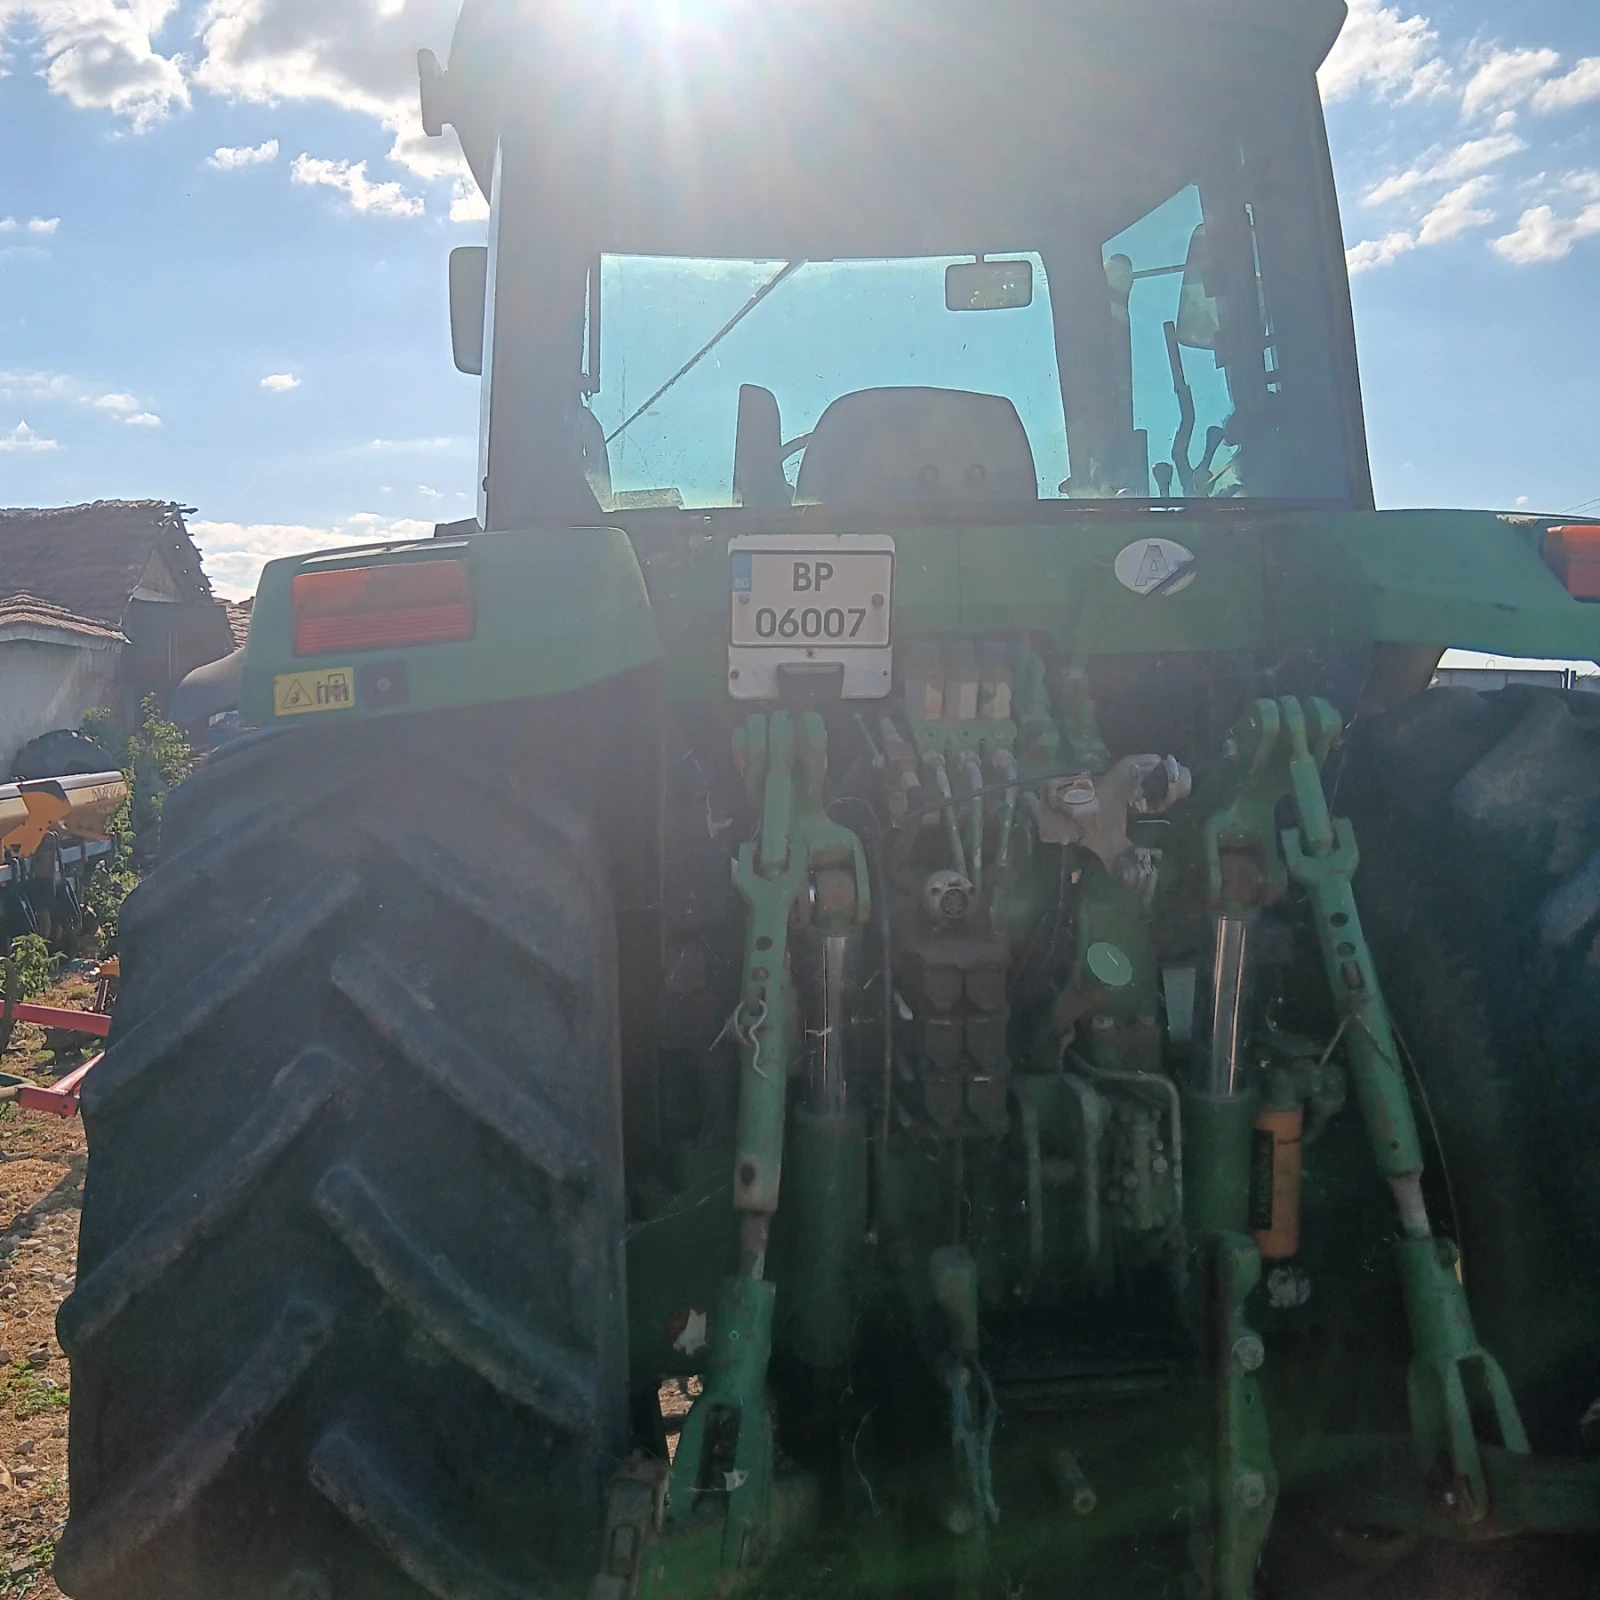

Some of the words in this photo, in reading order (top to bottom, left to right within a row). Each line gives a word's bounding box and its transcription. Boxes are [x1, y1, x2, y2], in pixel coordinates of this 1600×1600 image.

[734, 577, 750, 588] BG
[792, 562, 834, 592] BP
[755, 607, 867, 638] 06007
